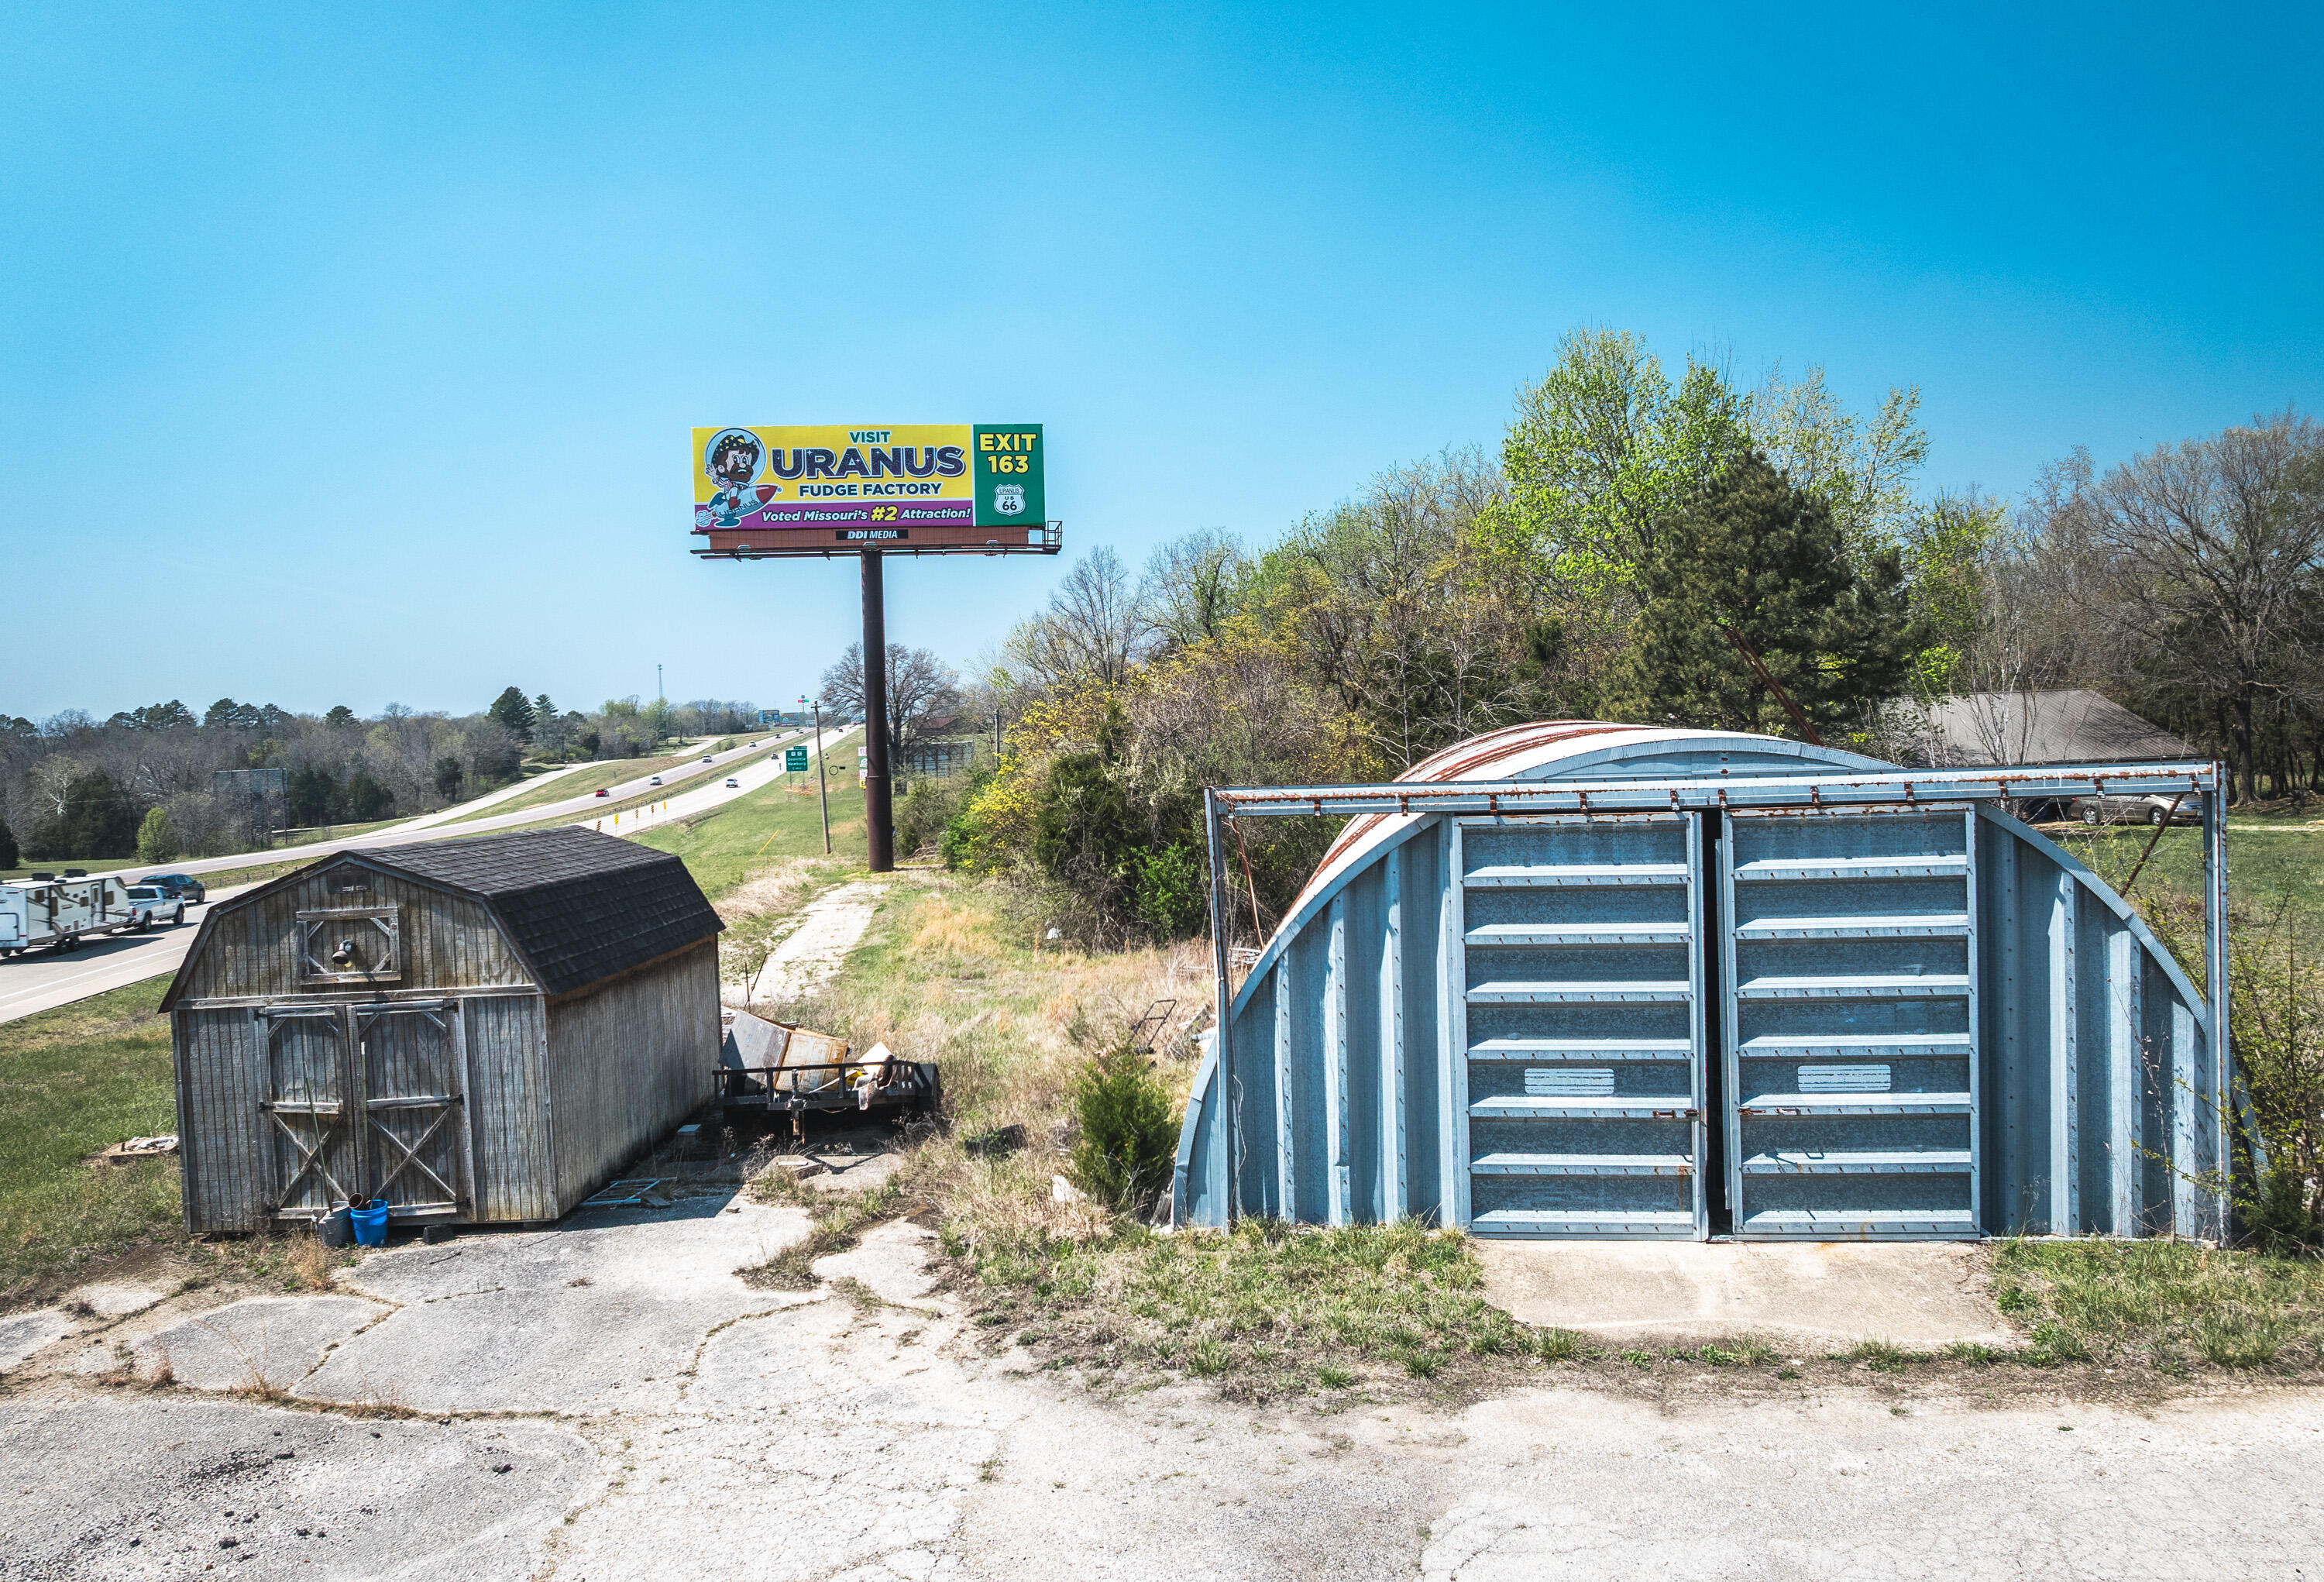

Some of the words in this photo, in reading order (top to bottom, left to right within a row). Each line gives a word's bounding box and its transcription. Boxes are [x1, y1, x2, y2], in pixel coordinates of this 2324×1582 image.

[849, 432, 891, 443] VISIT
[979, 433, 1037, 452] EXIT
[771, 445, 966, 479] URANUS
[988, 455, 1029, 473] 163
[799, 483, 858, 497] FUDGE
[863, 482, 942, 496] FACTORY
[719, 499, 758, 518] URANUS
[1002, 500, 1017, 511] 66
[761, 511, 801, 522] Voted
[803, 509, 868, 522] Missouri's
[871, 506, 898, 521] #2
[900, 507, 971, 520] Attraction!
[847, 531, 868, 539] DDI
[869, 530, 898, 538] MEDIA
